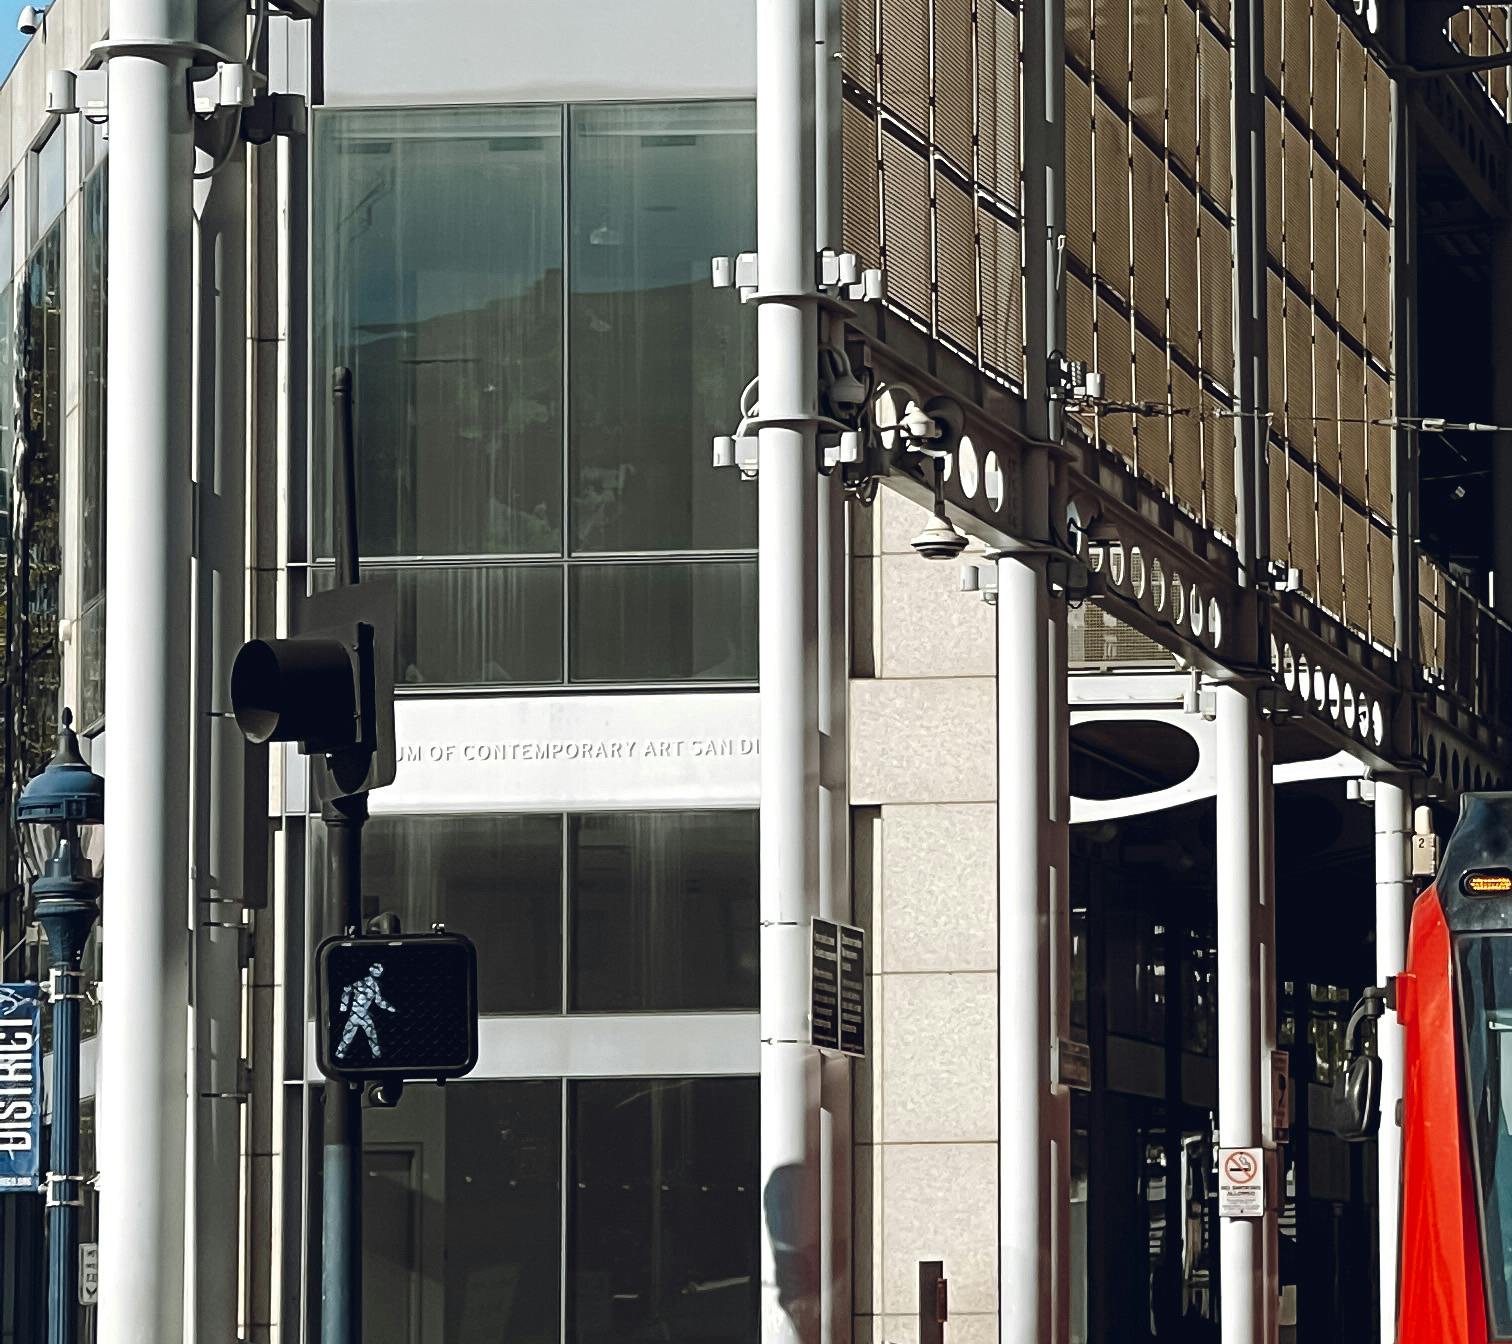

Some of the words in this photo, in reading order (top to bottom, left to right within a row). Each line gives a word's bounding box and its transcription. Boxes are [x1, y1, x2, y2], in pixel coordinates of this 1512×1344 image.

[430, 745, 456, 761] OF
[464, 741, 636, 761] CONTEMPORARY
[644, 740, 684, 757] ART
[692, 739, 733, 756] SAN
[1418, 837, 1425, 848] 2
